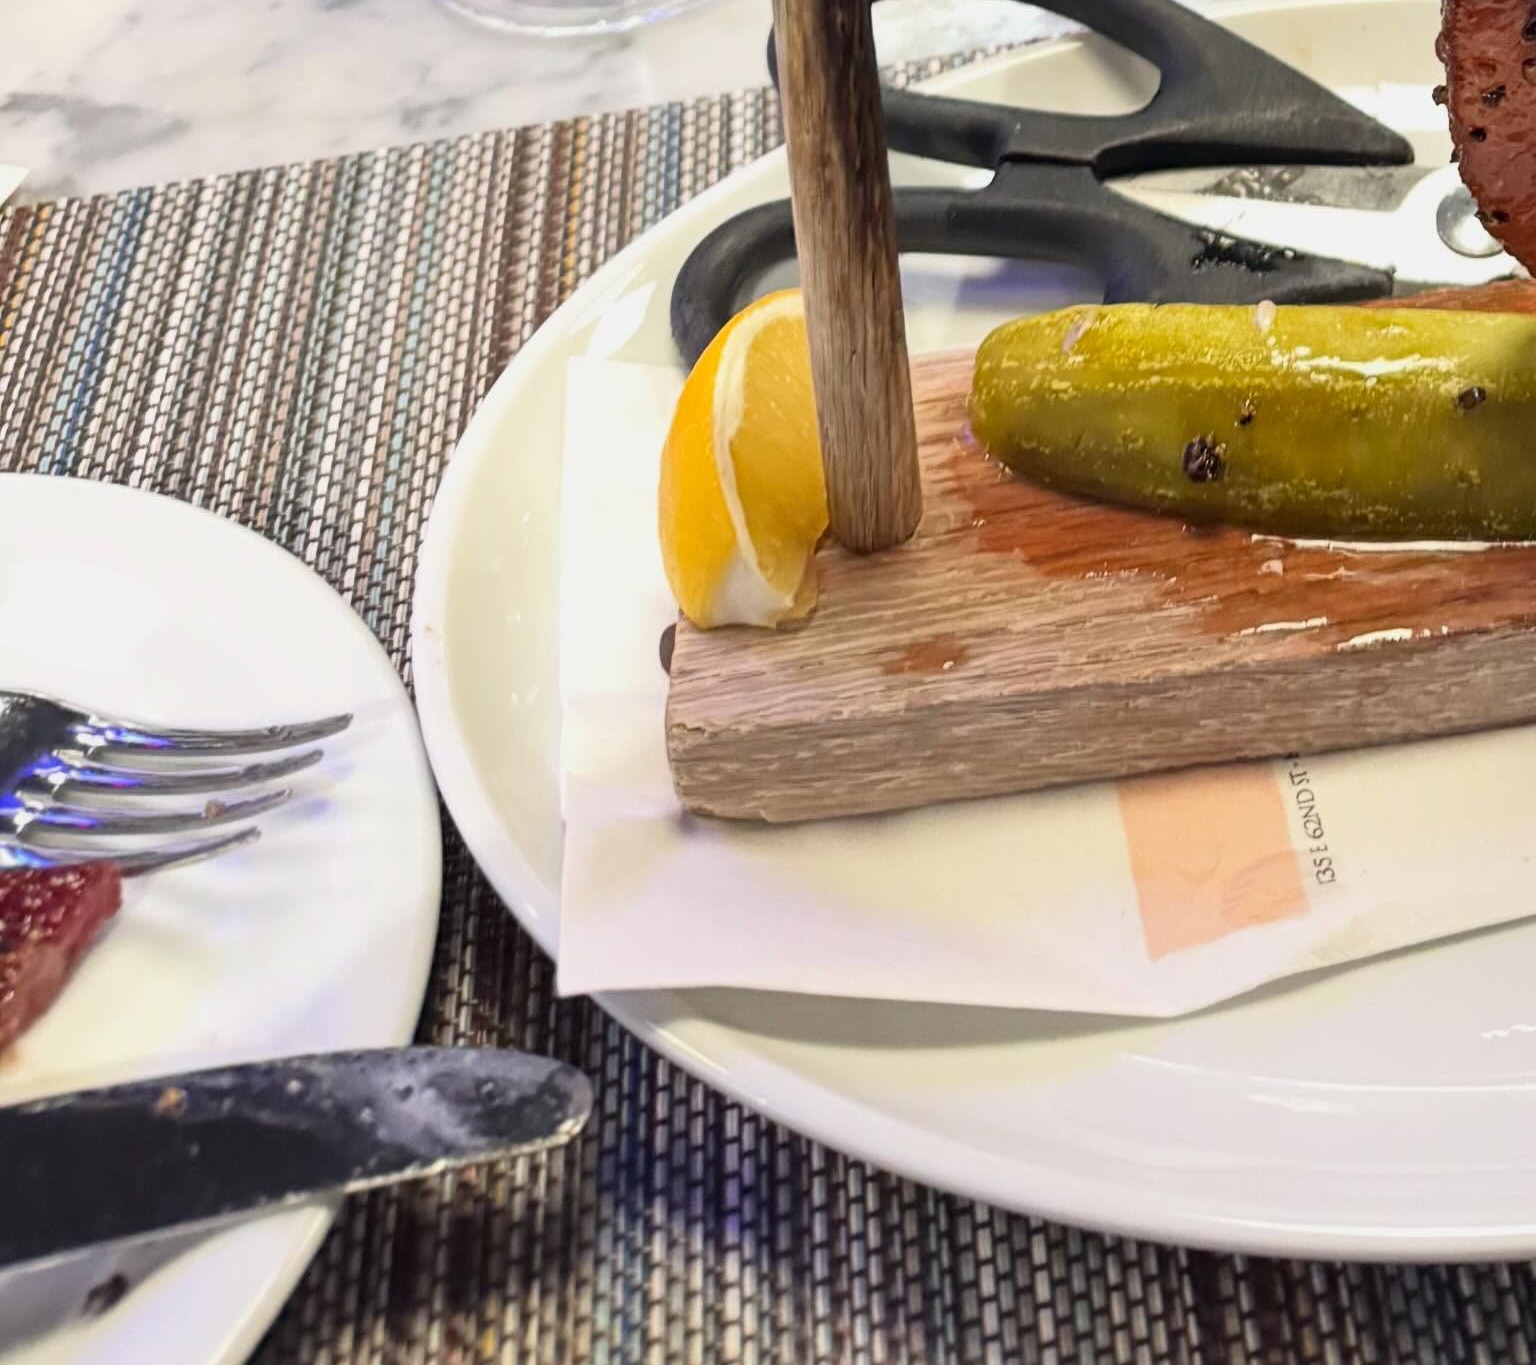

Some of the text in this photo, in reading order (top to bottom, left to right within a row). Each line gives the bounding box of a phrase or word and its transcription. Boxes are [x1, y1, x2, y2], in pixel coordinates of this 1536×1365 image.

[1288, 770, 1310, 786] ST
[1296, 788, 1324, 839] 62ND
[1309, 843, 1328, 853] E
[1313, 857, 1337, 885] 135
